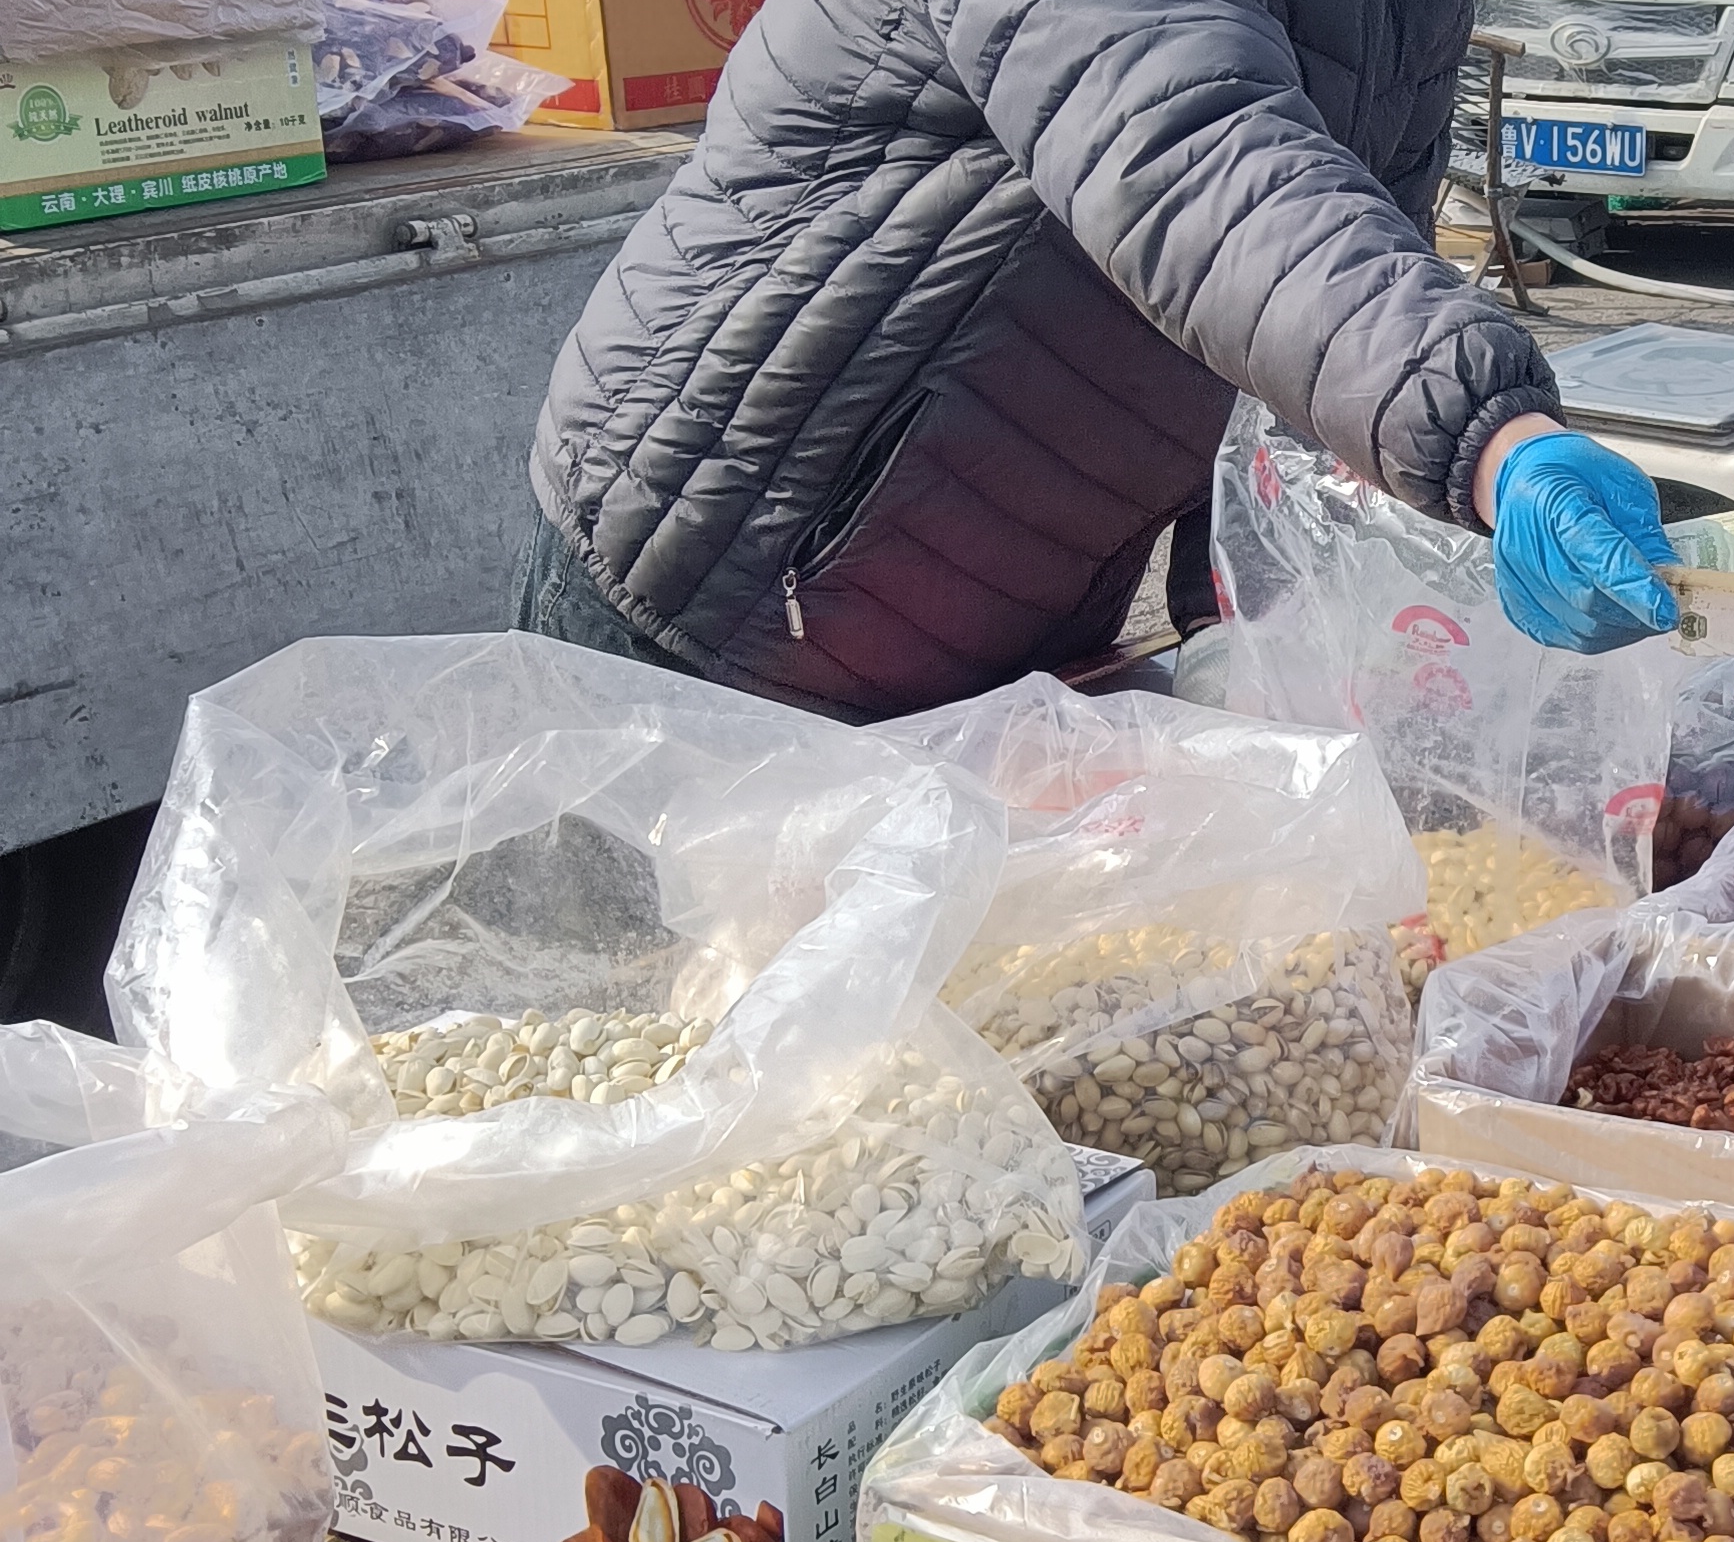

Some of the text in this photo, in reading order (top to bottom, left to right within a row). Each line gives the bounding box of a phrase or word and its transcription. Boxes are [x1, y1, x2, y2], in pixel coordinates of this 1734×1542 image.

[95, 101, 250, 137] Leatheroid walnut
[181, 161, 288, 194] 纸皮核桃原产地
